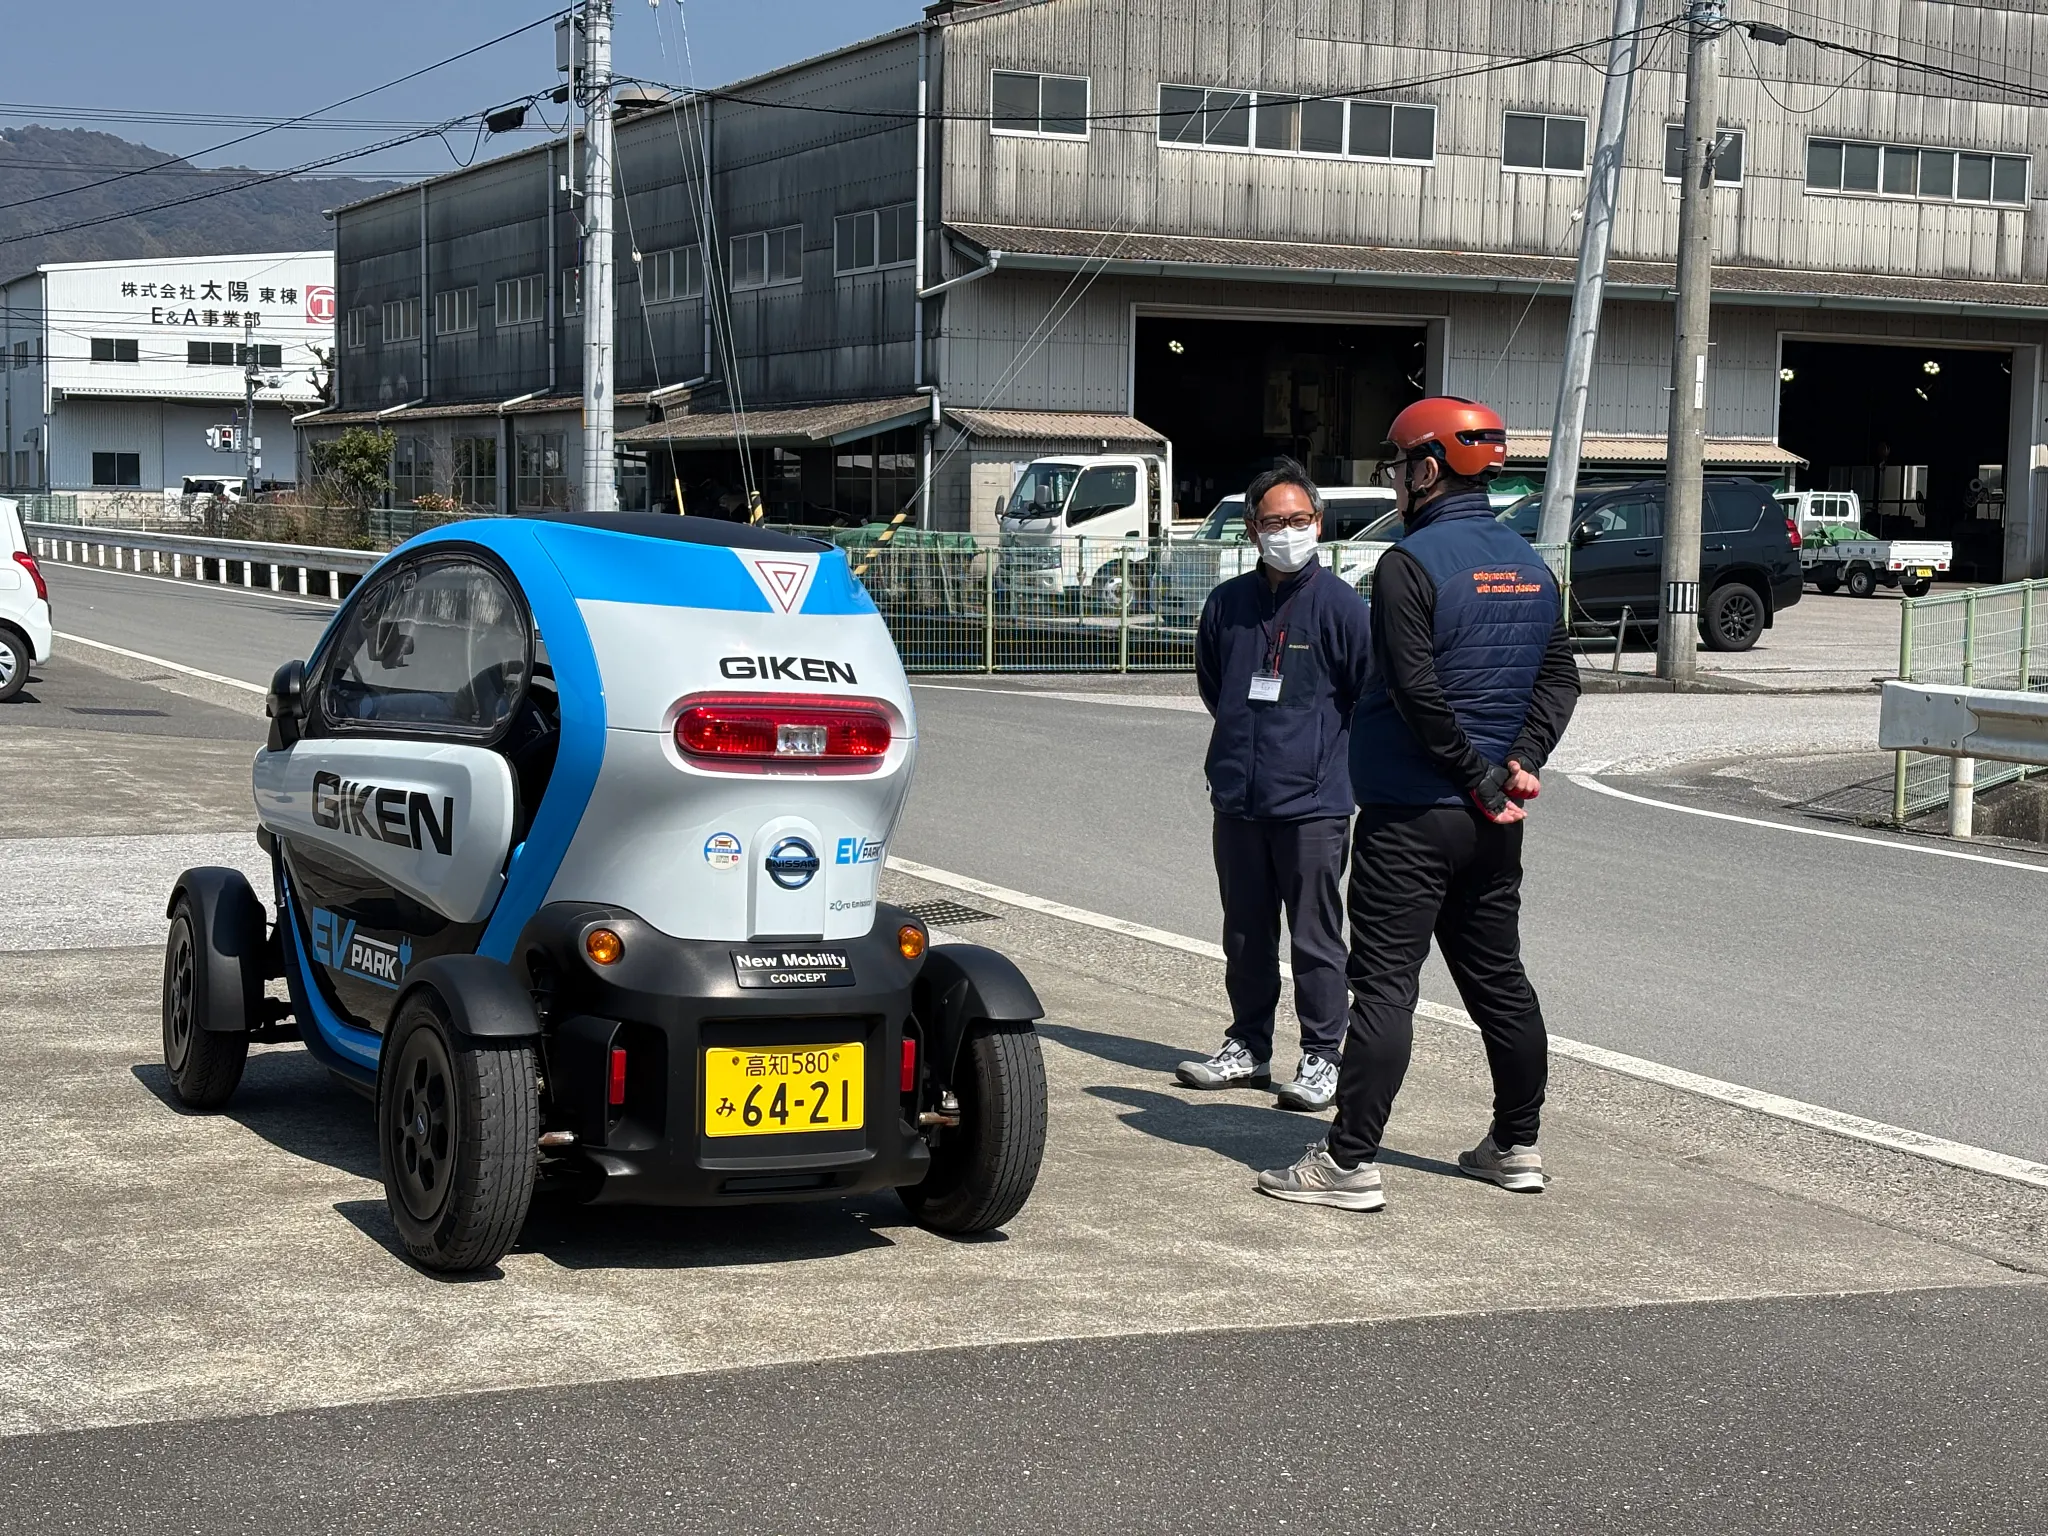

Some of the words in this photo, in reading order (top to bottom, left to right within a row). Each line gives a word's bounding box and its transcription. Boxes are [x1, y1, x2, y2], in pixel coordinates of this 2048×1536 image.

[121, 280, 250, 302] 株式会社太陽
[258, 287, 298, 305] 東棟
[151, 306, 261, 328] E&A事業部
[1476, 584, 1490, 593] with
[1492, 584, 1514, 593] motion
[719, 656, 858, 685] GIKEN
[312, 770, 454, 856] GIKEN
[835, 837, 867, 865] EV
[862, 848, 880, 859] PARK
[772, 860, 816, 869] NISSAN
[312, 906, 356, 970] EV
[351, 943, 398, 981] PARK
[736, 955, 777, 967] New
[782, 953, 846, 967] Mobility
[770, 973, 827, 983] CONCEPT
[715, 1097, 736, 1118] み
[742, 1079, 849, 1127] 64-21
